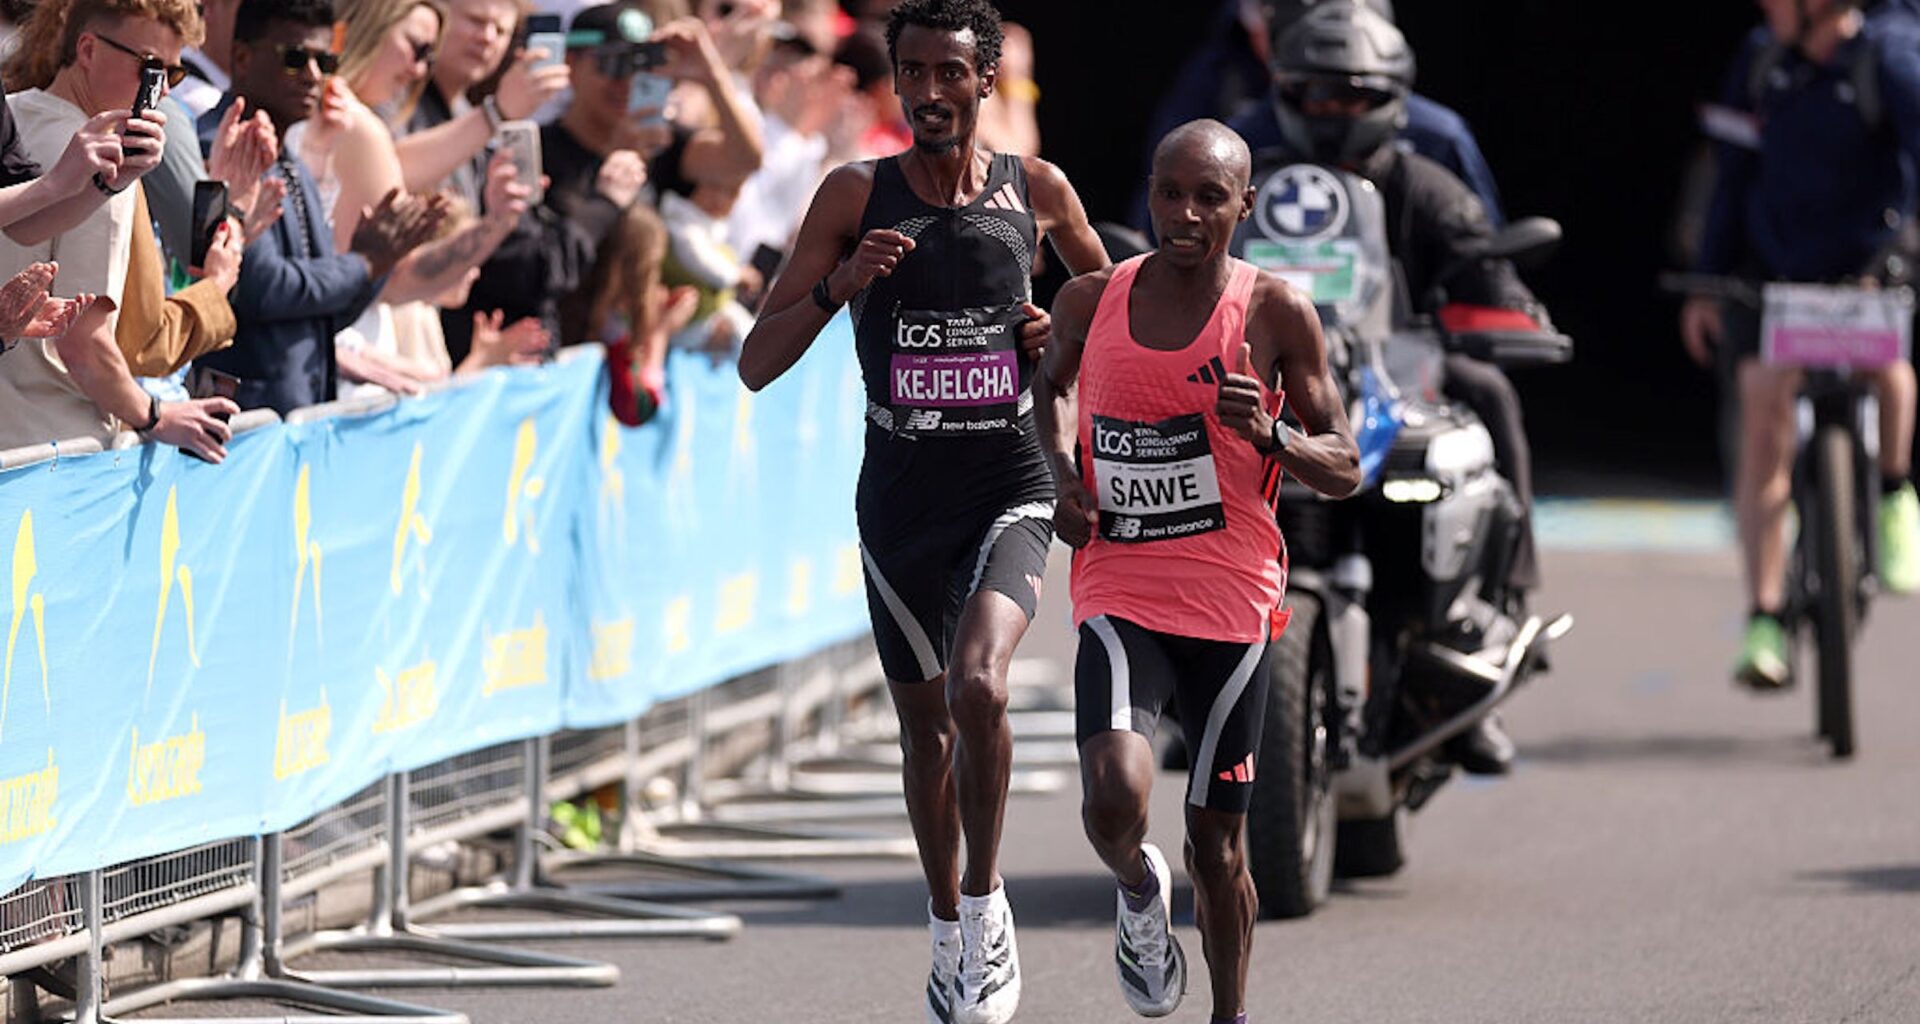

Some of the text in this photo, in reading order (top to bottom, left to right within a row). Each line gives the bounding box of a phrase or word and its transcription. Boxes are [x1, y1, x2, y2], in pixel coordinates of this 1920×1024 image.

[897, 317, 942, 347] tcs
[946, 318, 974, 327] TATA
[895, 366, 1013, 400] KEJELCHA
[942, 422, 964, 430] new
[966, 418, 1008, 430] balance
[1134, 428, 1161, 437] TAT
[1096, 423, 1132, 456] tcs
[1110, 473, 1200, 507] SAWE
[1143, 526, 1165, 537] new
[1167, 518, 1214, 534] balance
